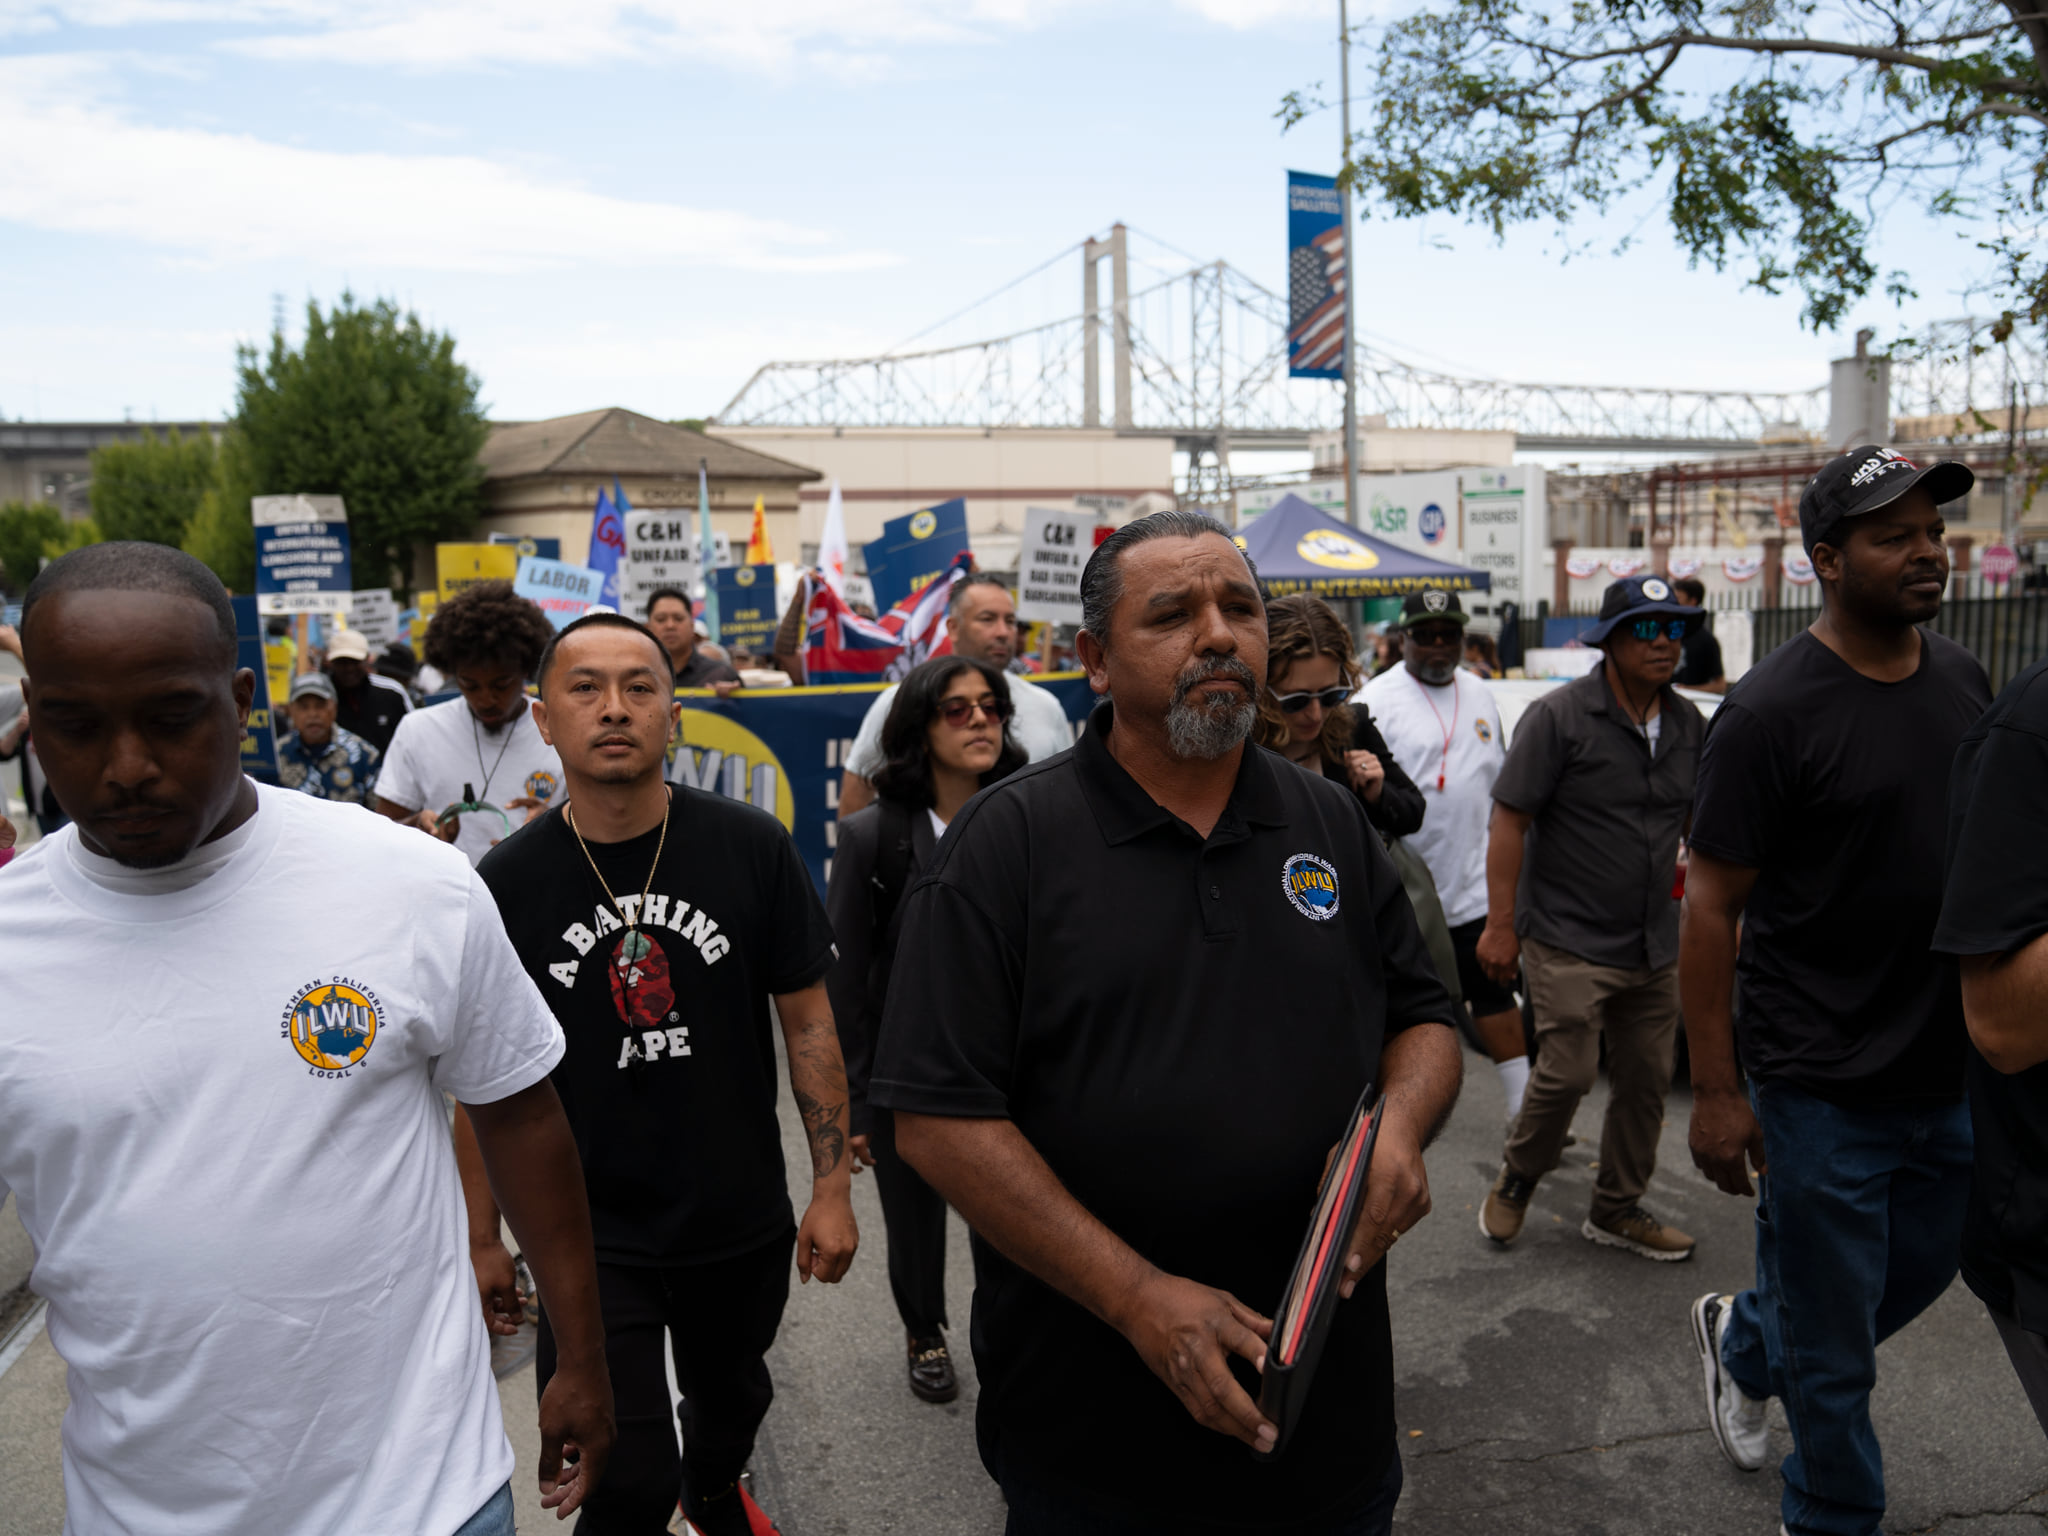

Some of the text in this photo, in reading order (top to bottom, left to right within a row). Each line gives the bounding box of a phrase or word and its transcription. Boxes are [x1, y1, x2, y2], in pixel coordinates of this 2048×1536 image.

[1290, 198, 1340, 214] SALUTES
[1374, 506, 1408, 532] ASR
[1470, 511, 1518, 523] BUSINESS
[636, 522, 682, 541] C&H
[263, 536, 341, 552] INTERNATIONAL
[261, 550, 344, 567] LONGSHORE AND
[631, 549, 690, 563] UNFAIR
[1034, 549, 1069, 565] UNFAIR
[1471, 553, 1516, 567] VISITORS
[528, 567, 591, 595] LABOR
[1312, 577, 1475, 597] INTERNATIONAL
[721, 621, 777, 636] CONTRACT
[1291, 871, 1335, 894] ILWU
[549, 893, 731, 989] A BATHING
[281, 976, 387, 1039] NORTHERN CALIFORNIA
[297, 1002, 370, 1044] ILWU
[617, 1026, 692, 1069] APE
[309, 1067, 353, 1080] LOCAL
